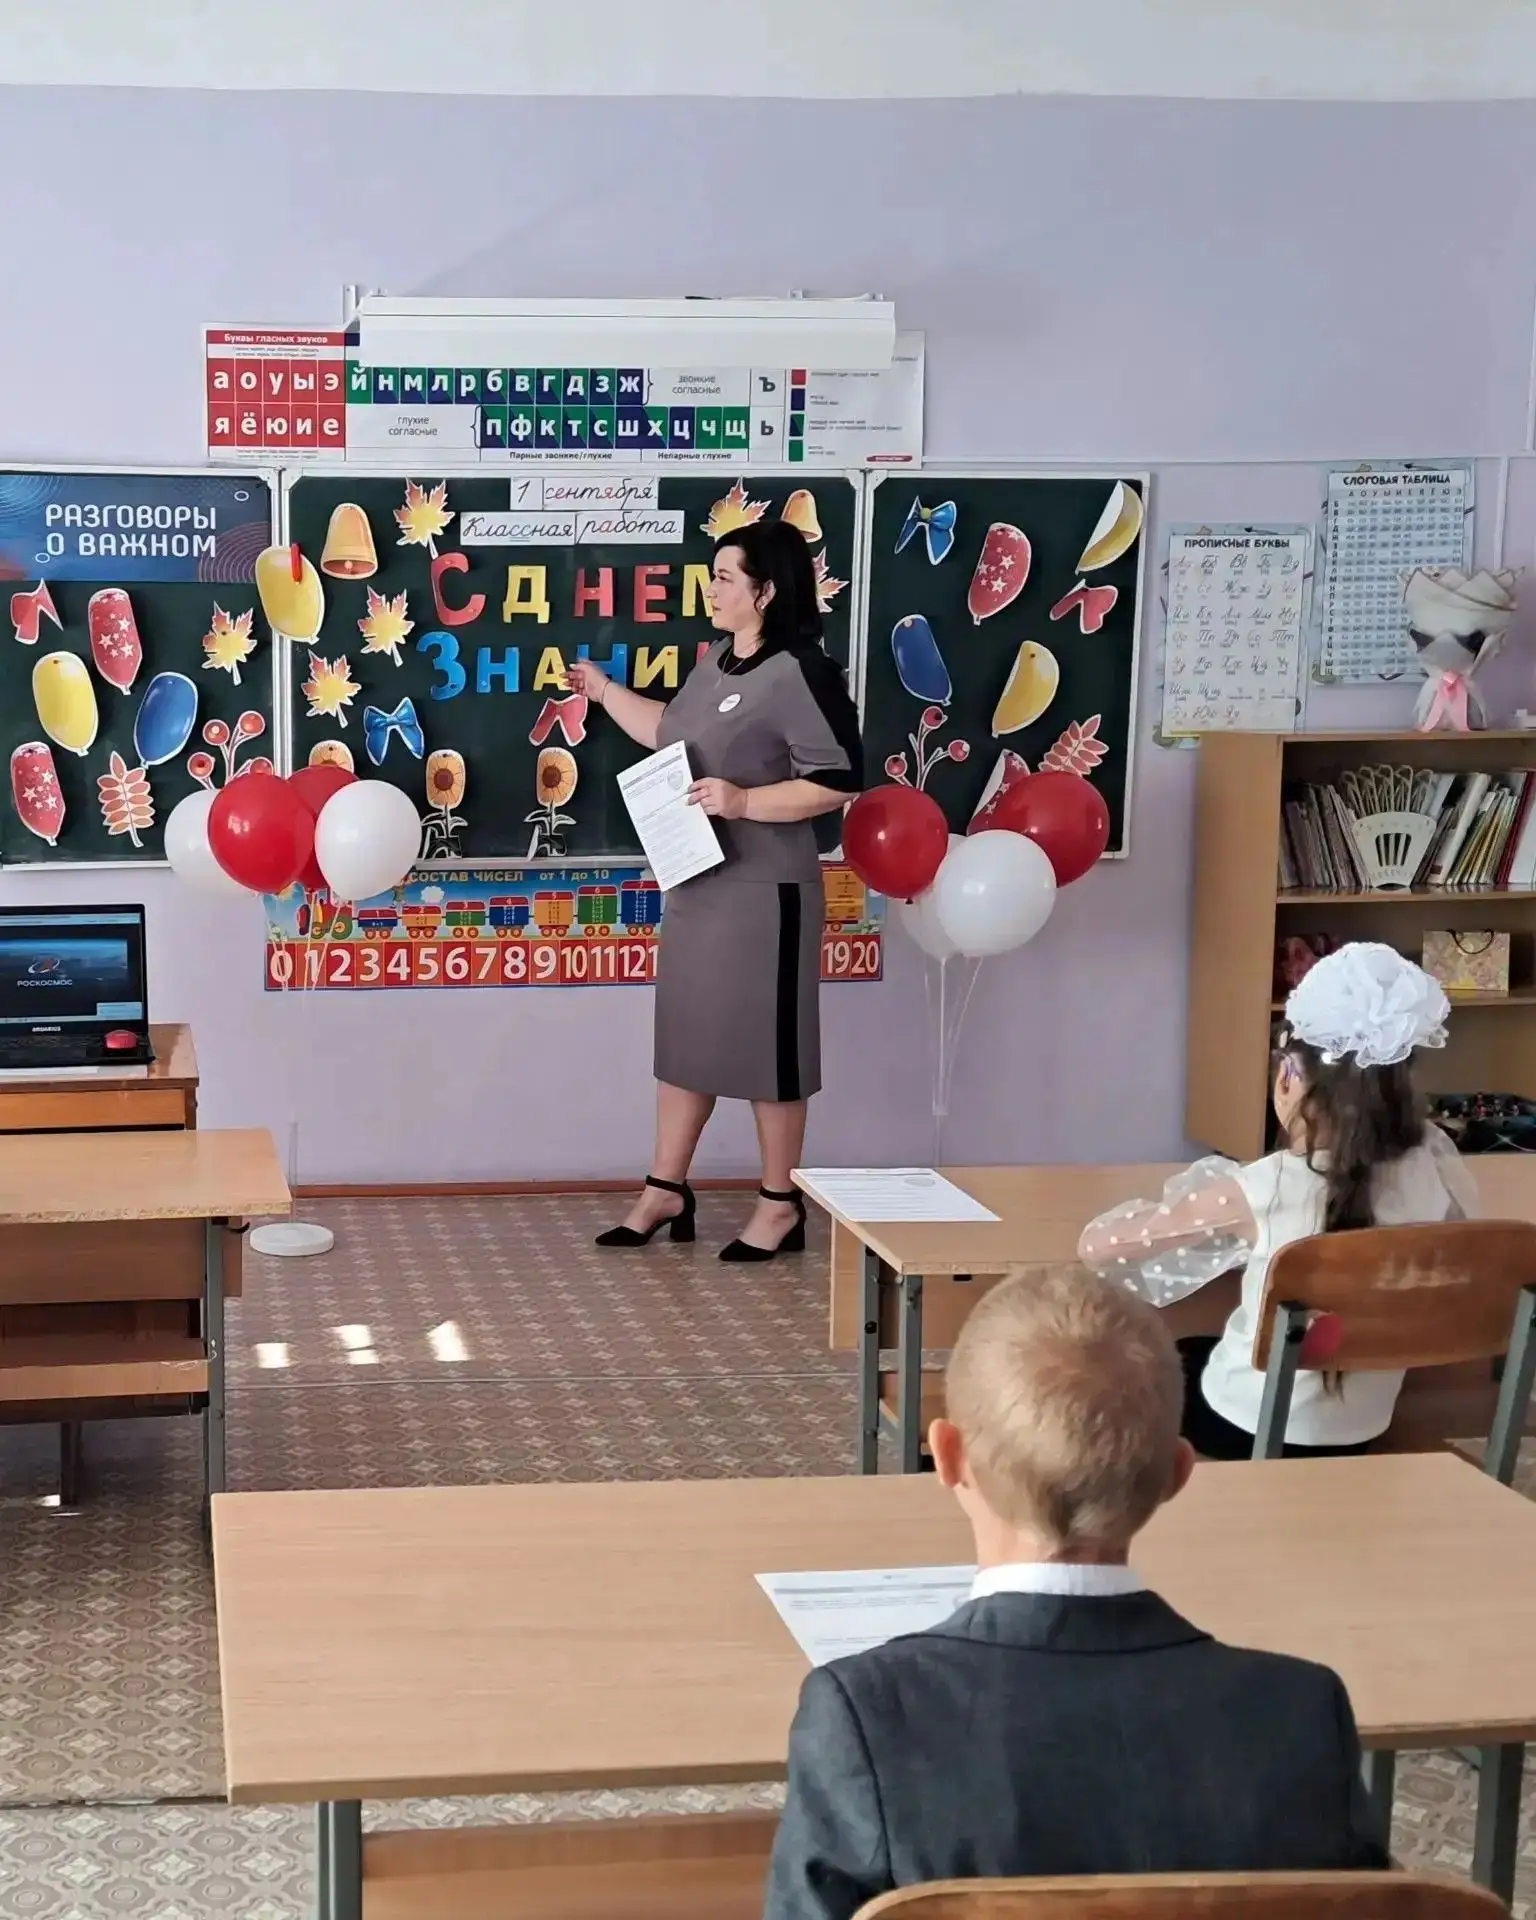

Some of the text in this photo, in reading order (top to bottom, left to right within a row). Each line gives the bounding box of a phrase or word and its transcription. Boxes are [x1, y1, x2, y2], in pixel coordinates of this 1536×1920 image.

[224, 333, 328, 344] Буквы гласных звуков
[678, 375, 716, 383] звонкие
[672, 386, 721, 394] согласные
[397, 416, 430, 426] глухие
[388, 427, 438, 436] согласные
[510, 452, 543, 460] Парные
[657, 452, 701, 460] Непарные
[1343, 475, 1450, 486] СЛОГОВАЯ ТАБЛИЦА
[517, 480, 531, 503] 1
[45, 504, 216, 530] РАЗГОВОРЫ
[462, 516, 574, 538] Классная
[46, 532, 216, 558] О ВАЖНОМ
[1184, 539, 1290, 548] ПРОПИСНЫЕ БУКВЫ
[431, 552, 486, 626] С
[416, 631, 710, 701] ЗНАНИ
[410, 869, 610, 882] СОСТАВ ЧИСЕЛ от 1 до 10
[270, 951, 293, 982] 0
[304, 950, 319, 982] 1
[330, 948, 352, 982] 2
[359, 948, 381, 981] 3
[387, 948, 411, 981] 4
[417, 947, 439, 980] 5
[445, 947, 469, 980] 6
[475, 947, 497, 979] 7
[503, 946, 527, 979] 8
[533, 946, 557, 979] 9
[561, 945, 588, 978] 10
[590, 946, 615, 978] 11
[619, 945, 646, 977] 12
[823, 941, 850, 974] 19
[851, 941, 879, 974] 20
[17, 979, 73, 987] РОСКОСМОС
